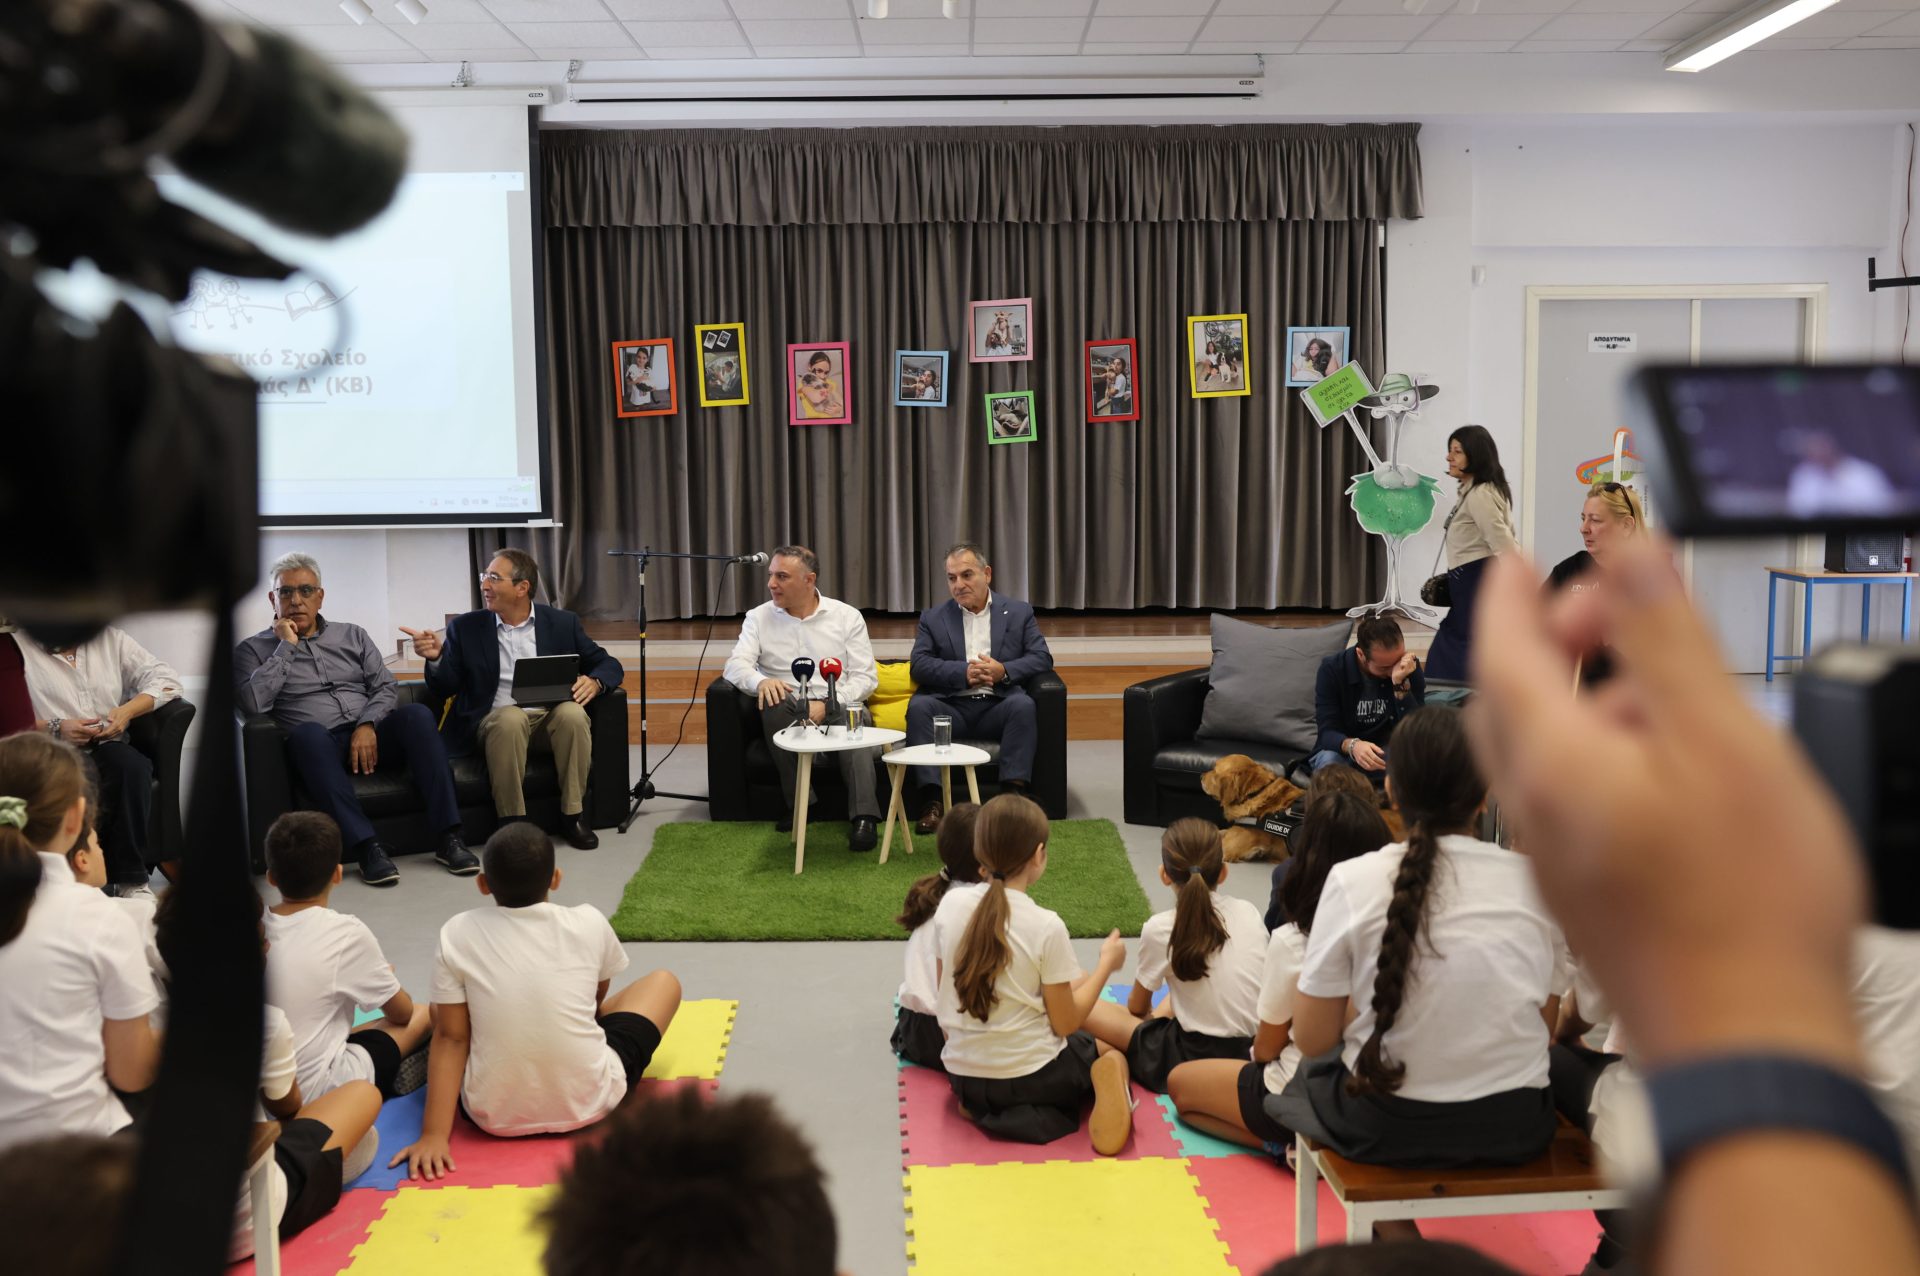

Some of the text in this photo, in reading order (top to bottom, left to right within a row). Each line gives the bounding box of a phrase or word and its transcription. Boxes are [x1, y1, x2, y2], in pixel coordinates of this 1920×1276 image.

[281, 348, 367, 370] Σχολείο
[326, 376, 373, 396] (ΚΒ)
[1266, 822, 1283, 832] GUIDE
